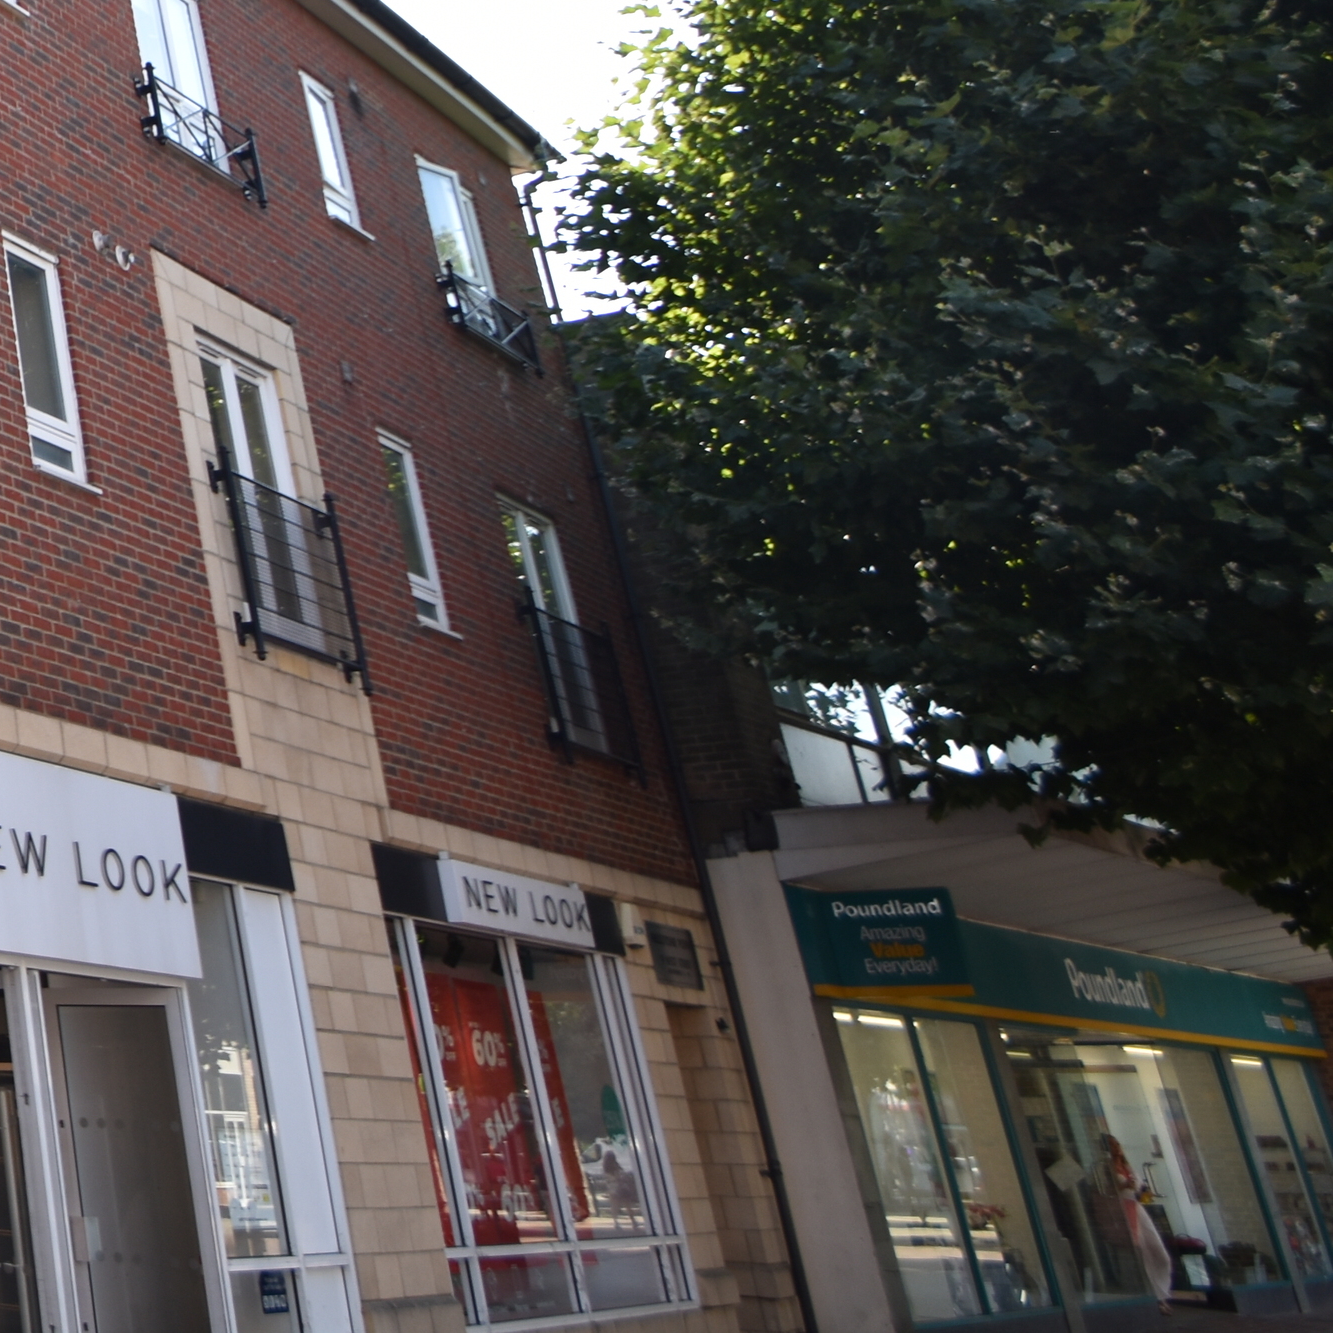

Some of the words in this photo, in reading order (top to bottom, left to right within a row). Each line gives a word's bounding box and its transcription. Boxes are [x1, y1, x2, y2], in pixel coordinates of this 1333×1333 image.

[72, 841, 188, 904] LOOK
[463, 876, 518, 917] NEW
[528, 891, 592, 932] LOOK
[832, 898, 942, 918] Poundland
[860, 924, 926, 942] Amazing
[869, 941, 925, 958] Value
[864, 956, 939, 975] Everyday!
[1064, 958, 1151, 1009] Poundland
[484, 1092, 521, 1149] SALE
